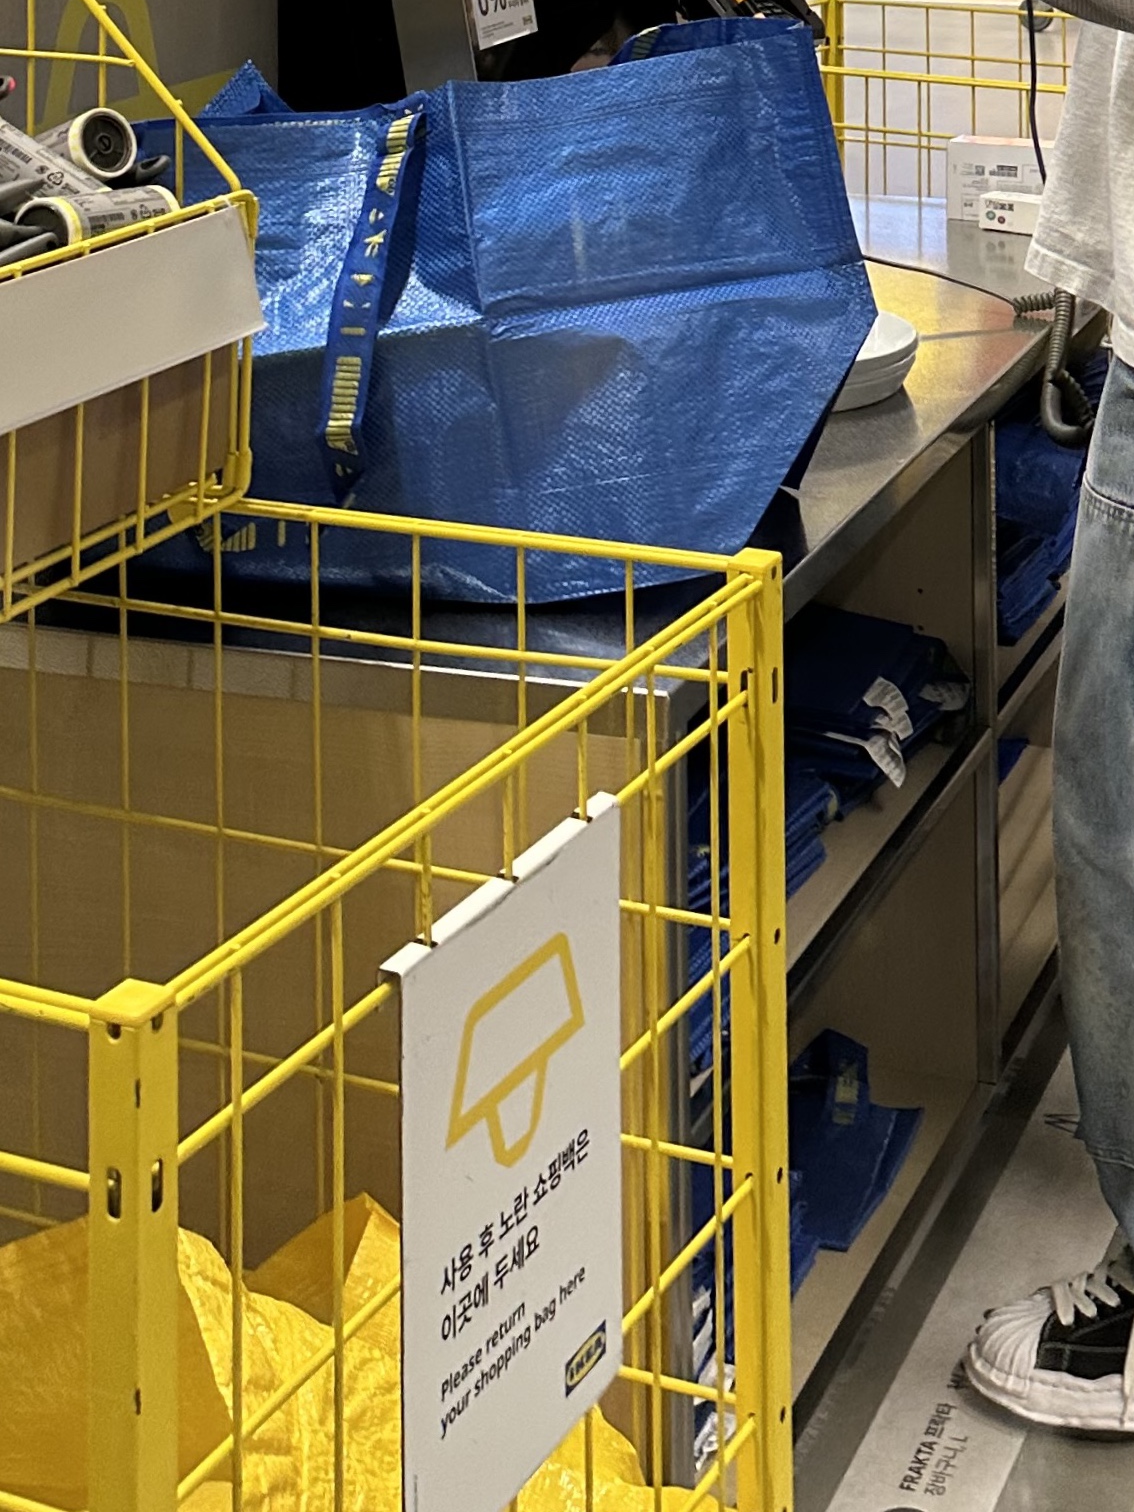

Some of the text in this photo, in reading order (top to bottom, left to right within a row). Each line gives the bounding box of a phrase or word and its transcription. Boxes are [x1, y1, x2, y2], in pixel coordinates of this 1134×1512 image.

[441, 1129, 590, 1295] 사용 후 노란 쇼핑백은
[441, 1225, 540, 1341] 이곳에 두세요
[441, 1302, 525, 1403] Please return
[441, 1267, 586, 1439] your shopping bag here
[567, 1330, 605, 1388] IKEA
[899, 1440, 939, 1492] FRAKTA
[924, 1402, 957, 1439] 프락타
[924, 1445, 967, 1496] 장바구니,
